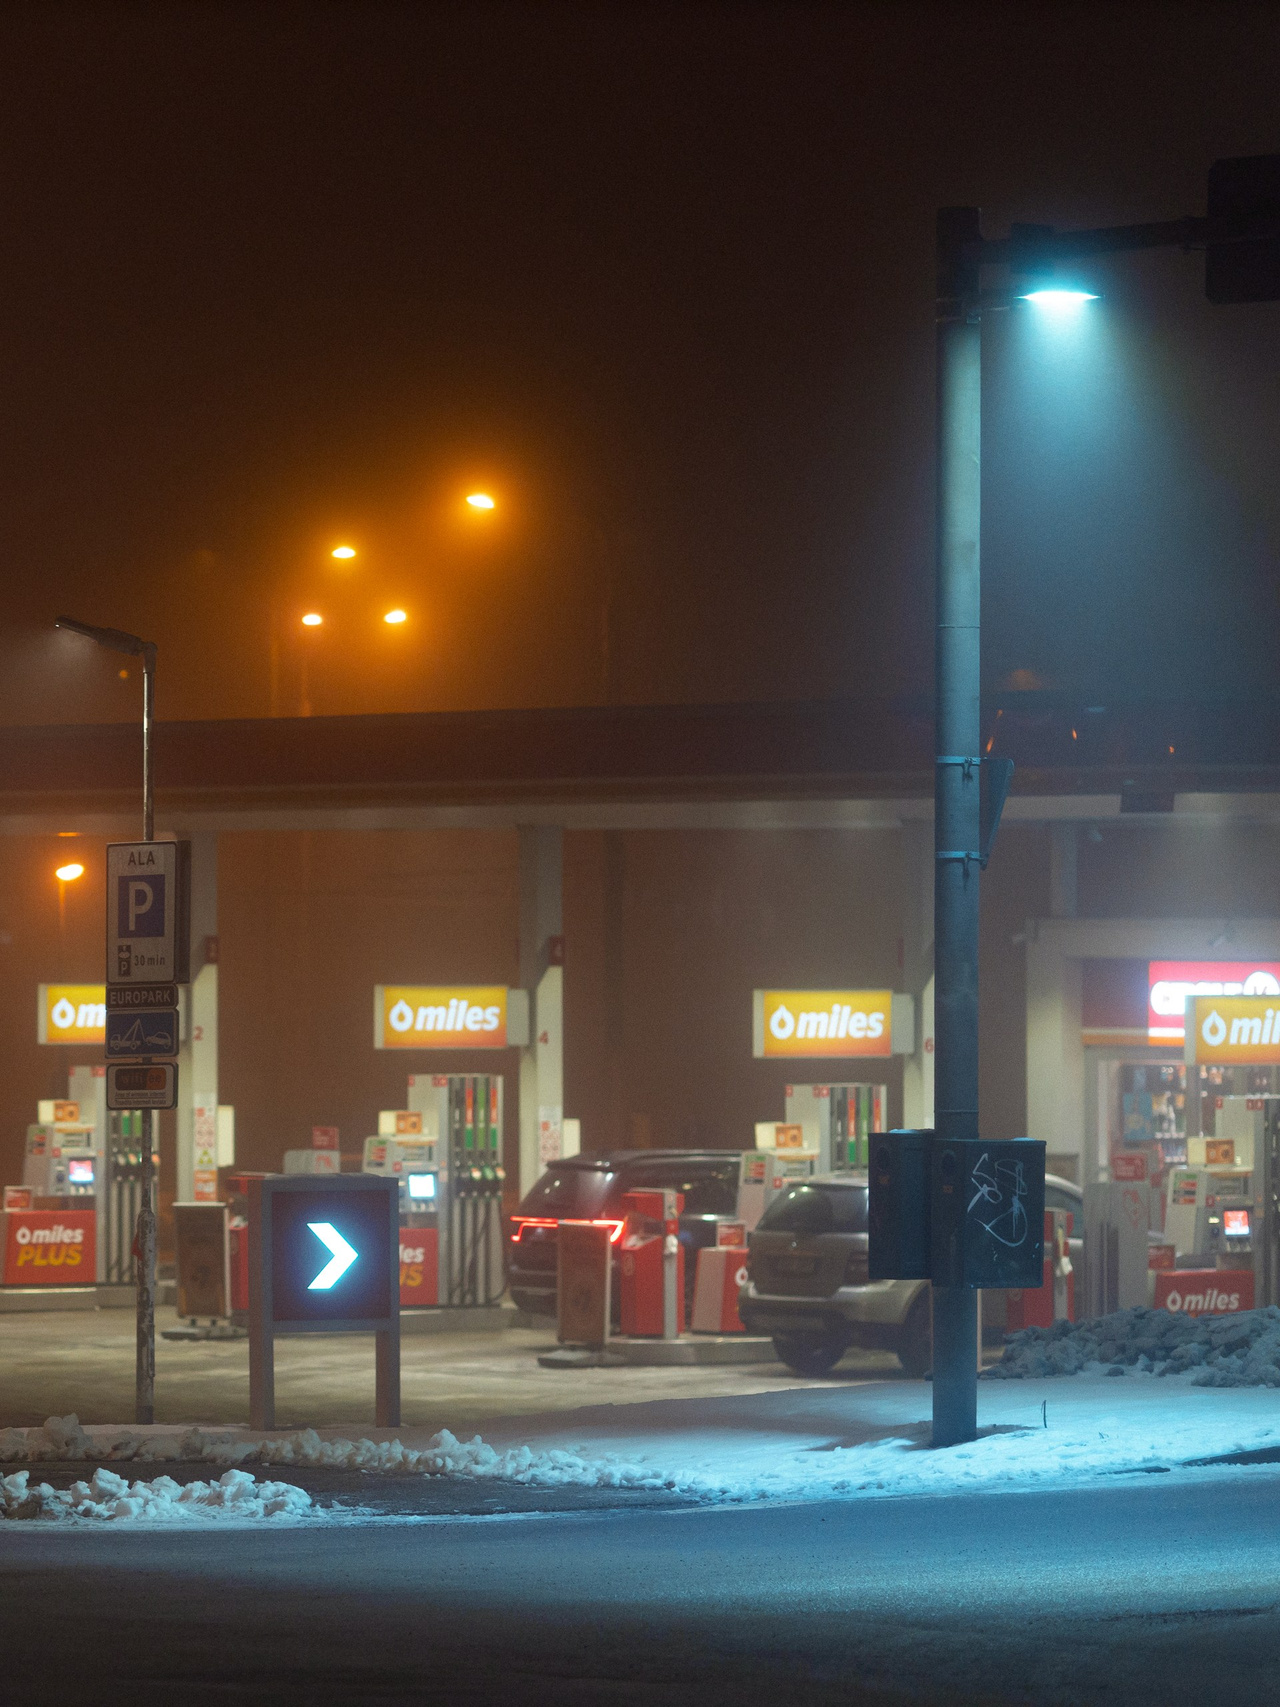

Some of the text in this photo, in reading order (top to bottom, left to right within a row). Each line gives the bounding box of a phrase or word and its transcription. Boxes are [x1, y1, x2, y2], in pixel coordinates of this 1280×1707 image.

[128, 851, 155, 866] ALA
[128, 881, 154, 931] P
[134, 951, 166, 966] 30 min
[110, 989, 171, 1004] EUROPARK
[415, 998, 500, 1030] miles
[796, 1004, 884, 1038] miles
[1228, 1008, 1280, 1046] mil
[31, 1226, 83, 1245] miles
[17, 1246, 82, 1266] PLUS
[399, 1244, 424, 1263] les
[1183, 1289, 1240, 1311] miles
